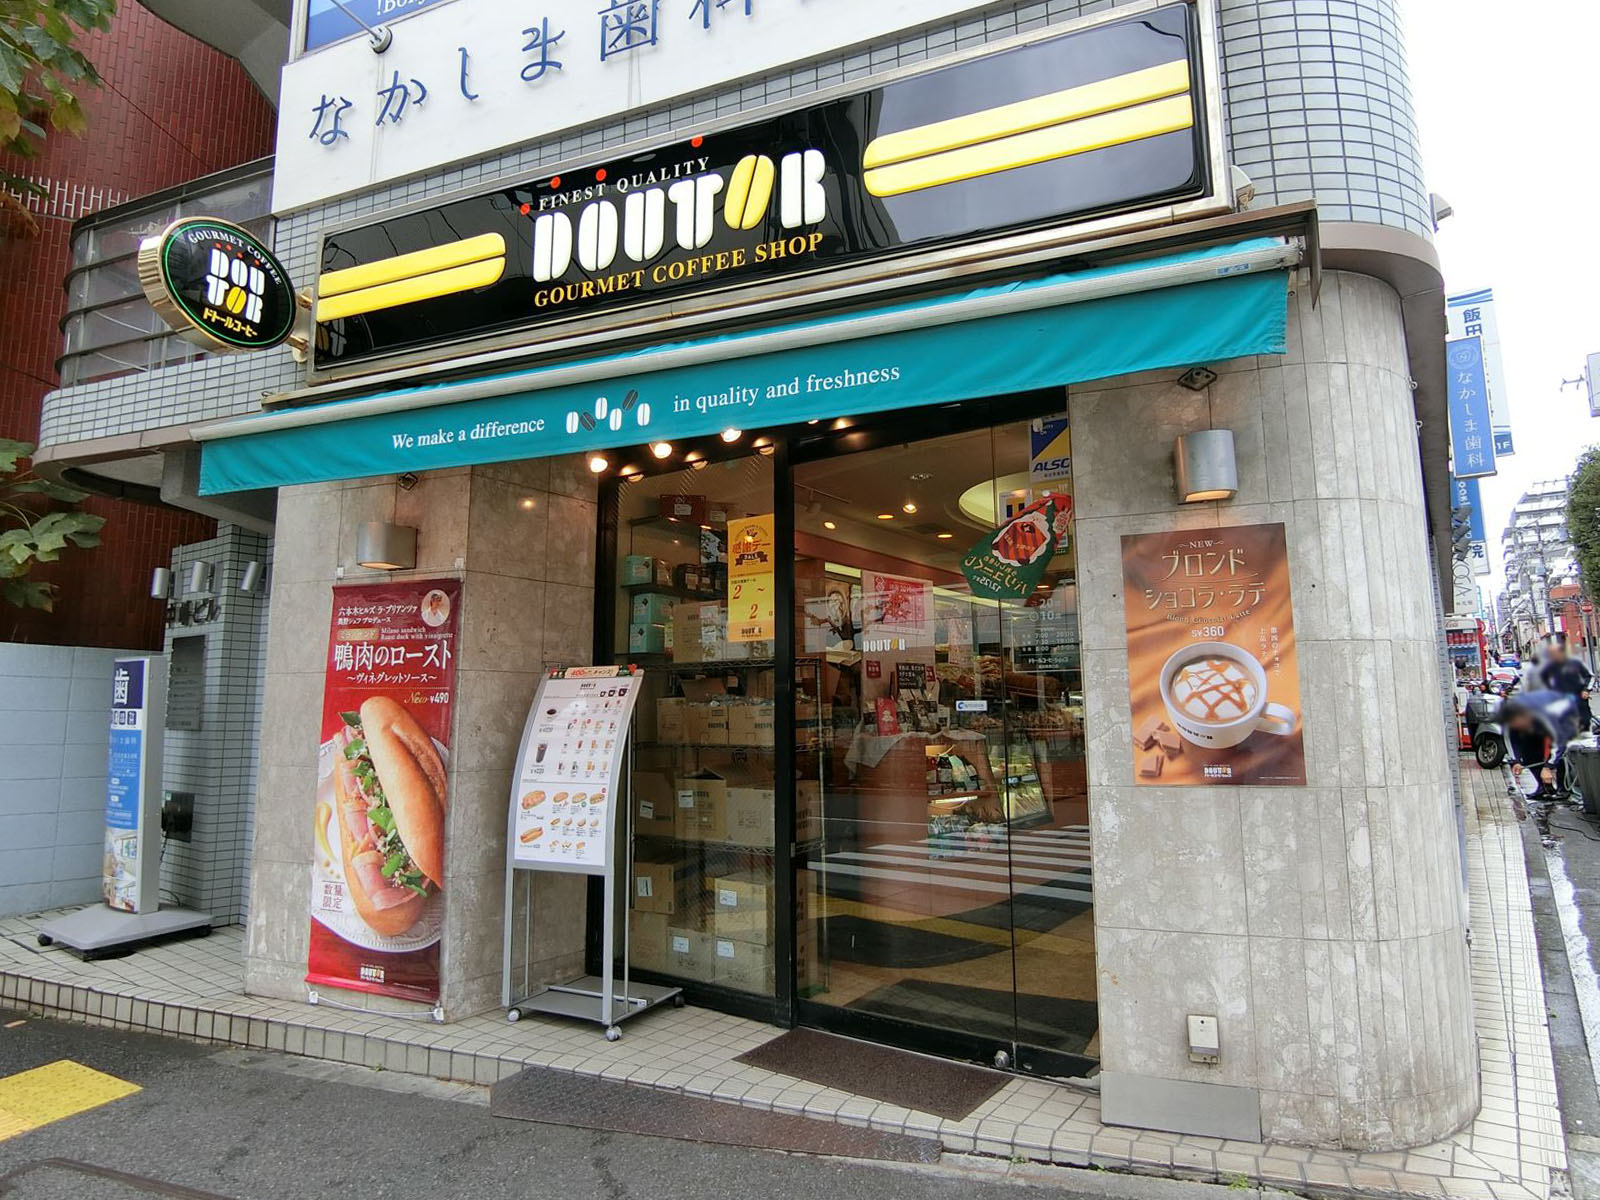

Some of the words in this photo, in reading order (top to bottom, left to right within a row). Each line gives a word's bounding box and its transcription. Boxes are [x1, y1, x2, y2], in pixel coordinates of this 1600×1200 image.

[538, 182, 607, 212] FINEST
[616, 156, 711, 194] QUALITY
[532, 148, 826, 283] DOUTOR
[188, 230, 245, 249] GOURMET
[247, 246, 282, 286] COFFEE
[533, 271, 644, 308] GOURMET
[653, 248, 746, 285] COFFEE
[754, 232, 824, 263] SHOP
[202, 307, 259, 339] ドトールコーヒー
[673, 395, 691, 413] in
[696, 387, 760, 415] quality
[766, 376, 800, 400] and
[806, 365, 901, 398] freshness
[392, 433, 415, 451] We
[417, 429, 455, 448] make
[459, 430, 467, 442] a
[470, 416, 546, 442] difference
[1457, 371, 1485, 468] なかしま歯科
[1189, 540, 1214, 549] NEW
[1162, 548, 1246, 580] ブロンド
[733, 585, 742, 600] 2
[1145, 582, 1267, 610] ショコラ・ラテ
[338, 606, 376, 617] 六本木ヒルズ
[749, 603, 759, 619] 2
[334, 640, 452, 671] 鴨肉のロースト
[863, 638, 906, 652] DOUTOR
[113, 668, 130, 706] 歯
[430, 692, 449, 704] ¥490
